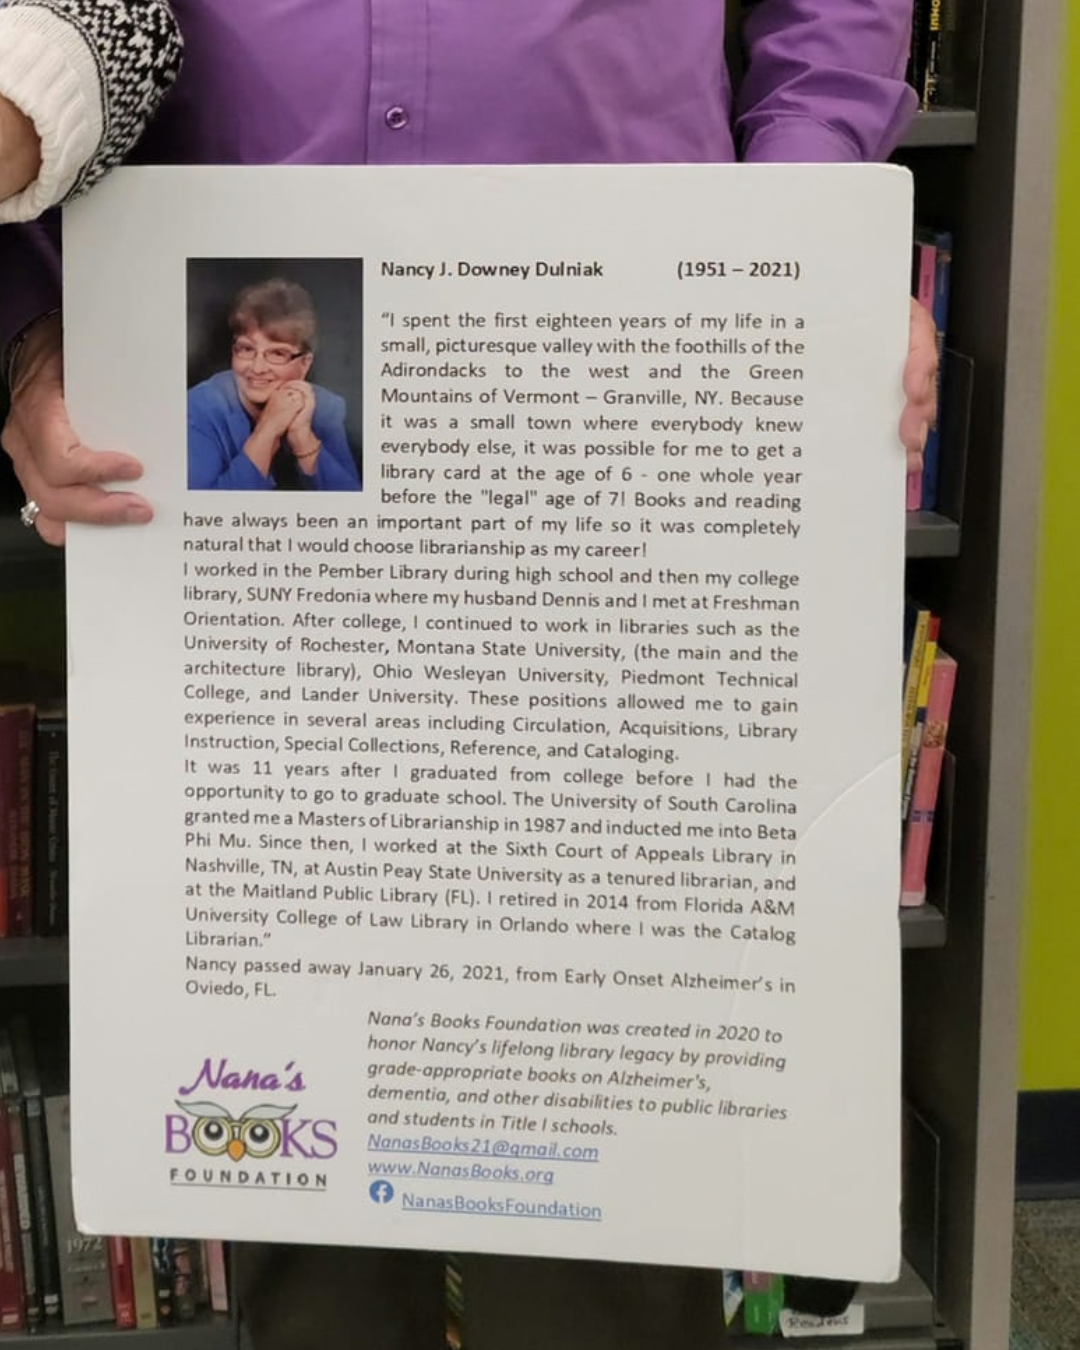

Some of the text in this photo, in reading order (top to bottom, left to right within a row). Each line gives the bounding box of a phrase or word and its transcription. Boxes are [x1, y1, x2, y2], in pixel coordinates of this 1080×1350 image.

[381, 261, 435, 280] Nancy
[439, 262, 452, 276] J.
[458, 261, 530, 280] Downey
[536, 261, 603, 277] Dulniak
[678, 261, 727, 280] (1951
[749, 261, 800, 280] 2021)
[368, 1011, 782, 1043] Nana's Books Foundation was created in 2020 to
[178, 1057, 306, 1096] Nana's
[368, 1062, 710, 1092] grade-appropriate books on Alzheimer's,
[164, 1113, 338, 1161] BOOKS
[368, 1111, 616, 1135] and students in Title I schools.
[367, 1133, 599, 1161] NanasBooks21@gmail.com
[170, 1166, 327, 1187] FOUNDATION
[367, 1161, 555, 1185] www.NanasBooks.org
[401, 1192, 602, 1220] NanasBooksFoundation
